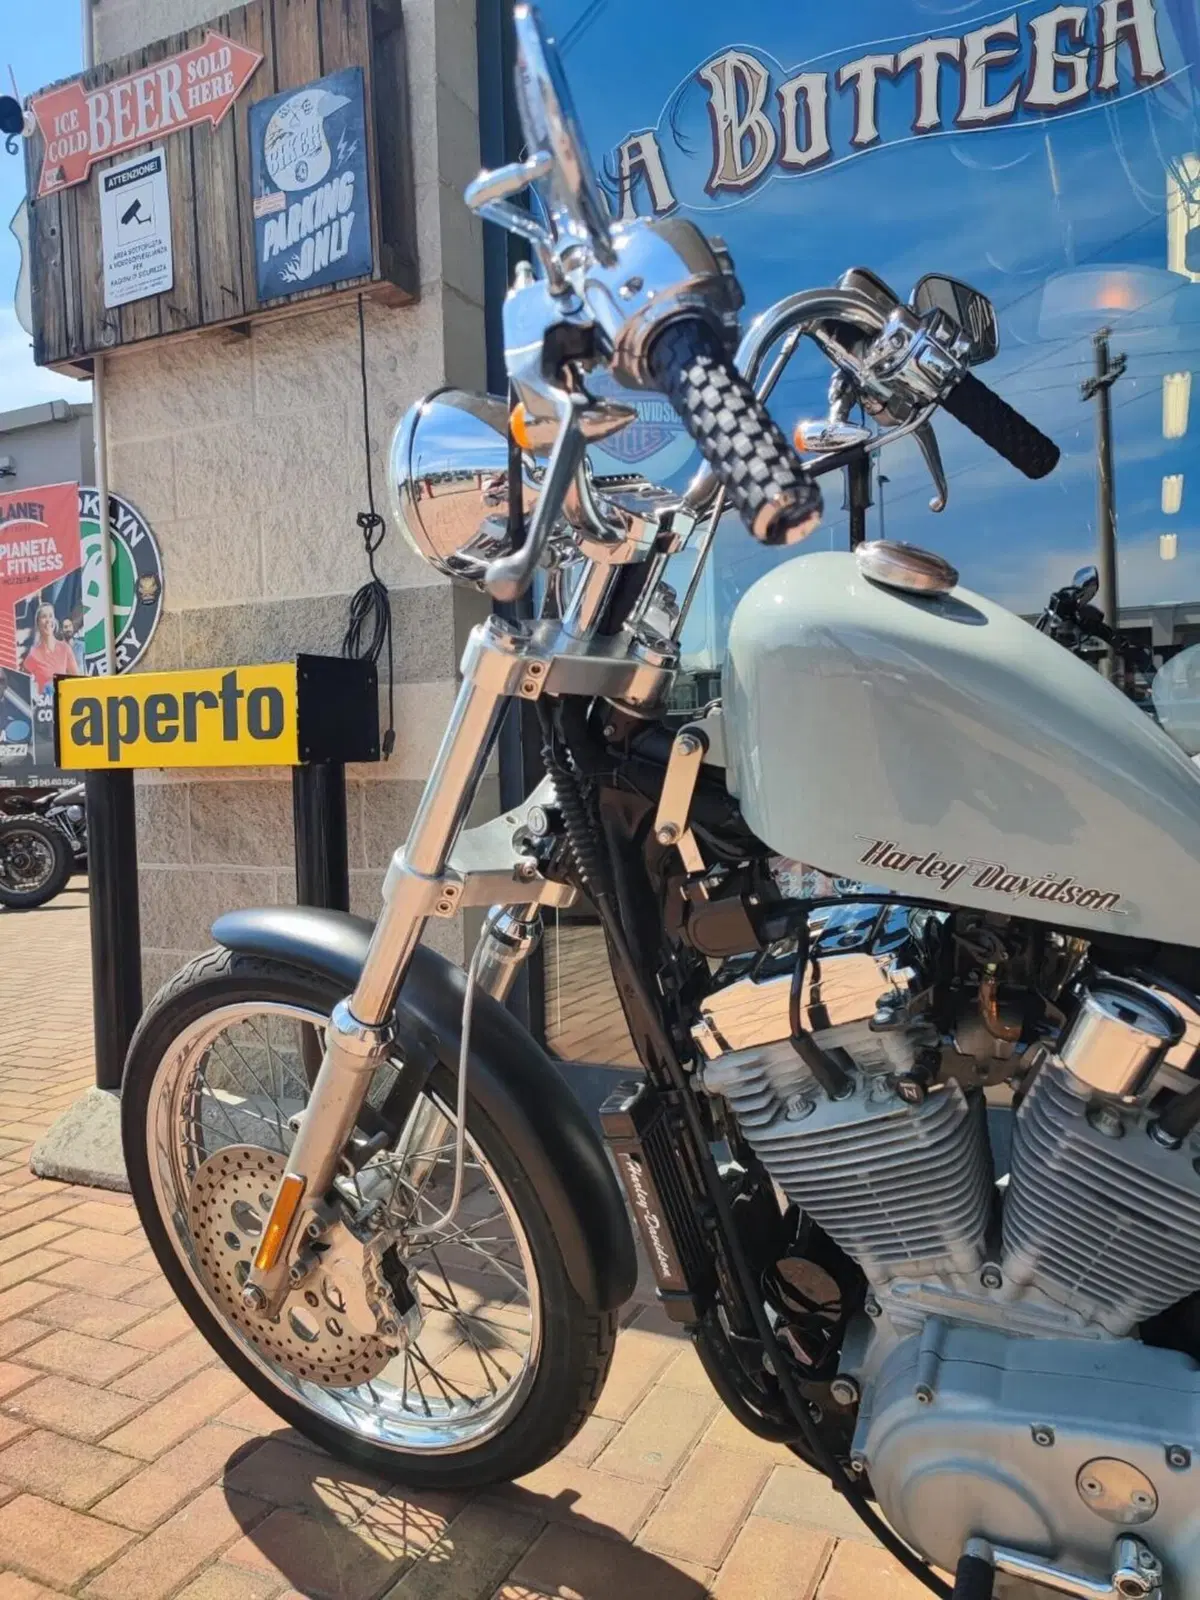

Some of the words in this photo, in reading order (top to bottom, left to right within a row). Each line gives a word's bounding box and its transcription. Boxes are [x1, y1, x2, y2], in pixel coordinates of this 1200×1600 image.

[187, 46, 232, 84] SOLD
[187, 71, 235, 109] HERE
[54, 109, 79, 137] ICE
[86, 63, 188, 155] BEER
[49, 130, 88, 163] COLD
[108, 160, 159, 188] ATTENZIONE!
[600, 131, 678, 222] A
[263, 170, 355, 263] PARKING
[298, 211, 355, 281] ONLY
[7, 553, 64, 577] FITNESS
[70, 670, 285, 762] aperto
[617, 1151, 672, 1278] Harley-Davidson
